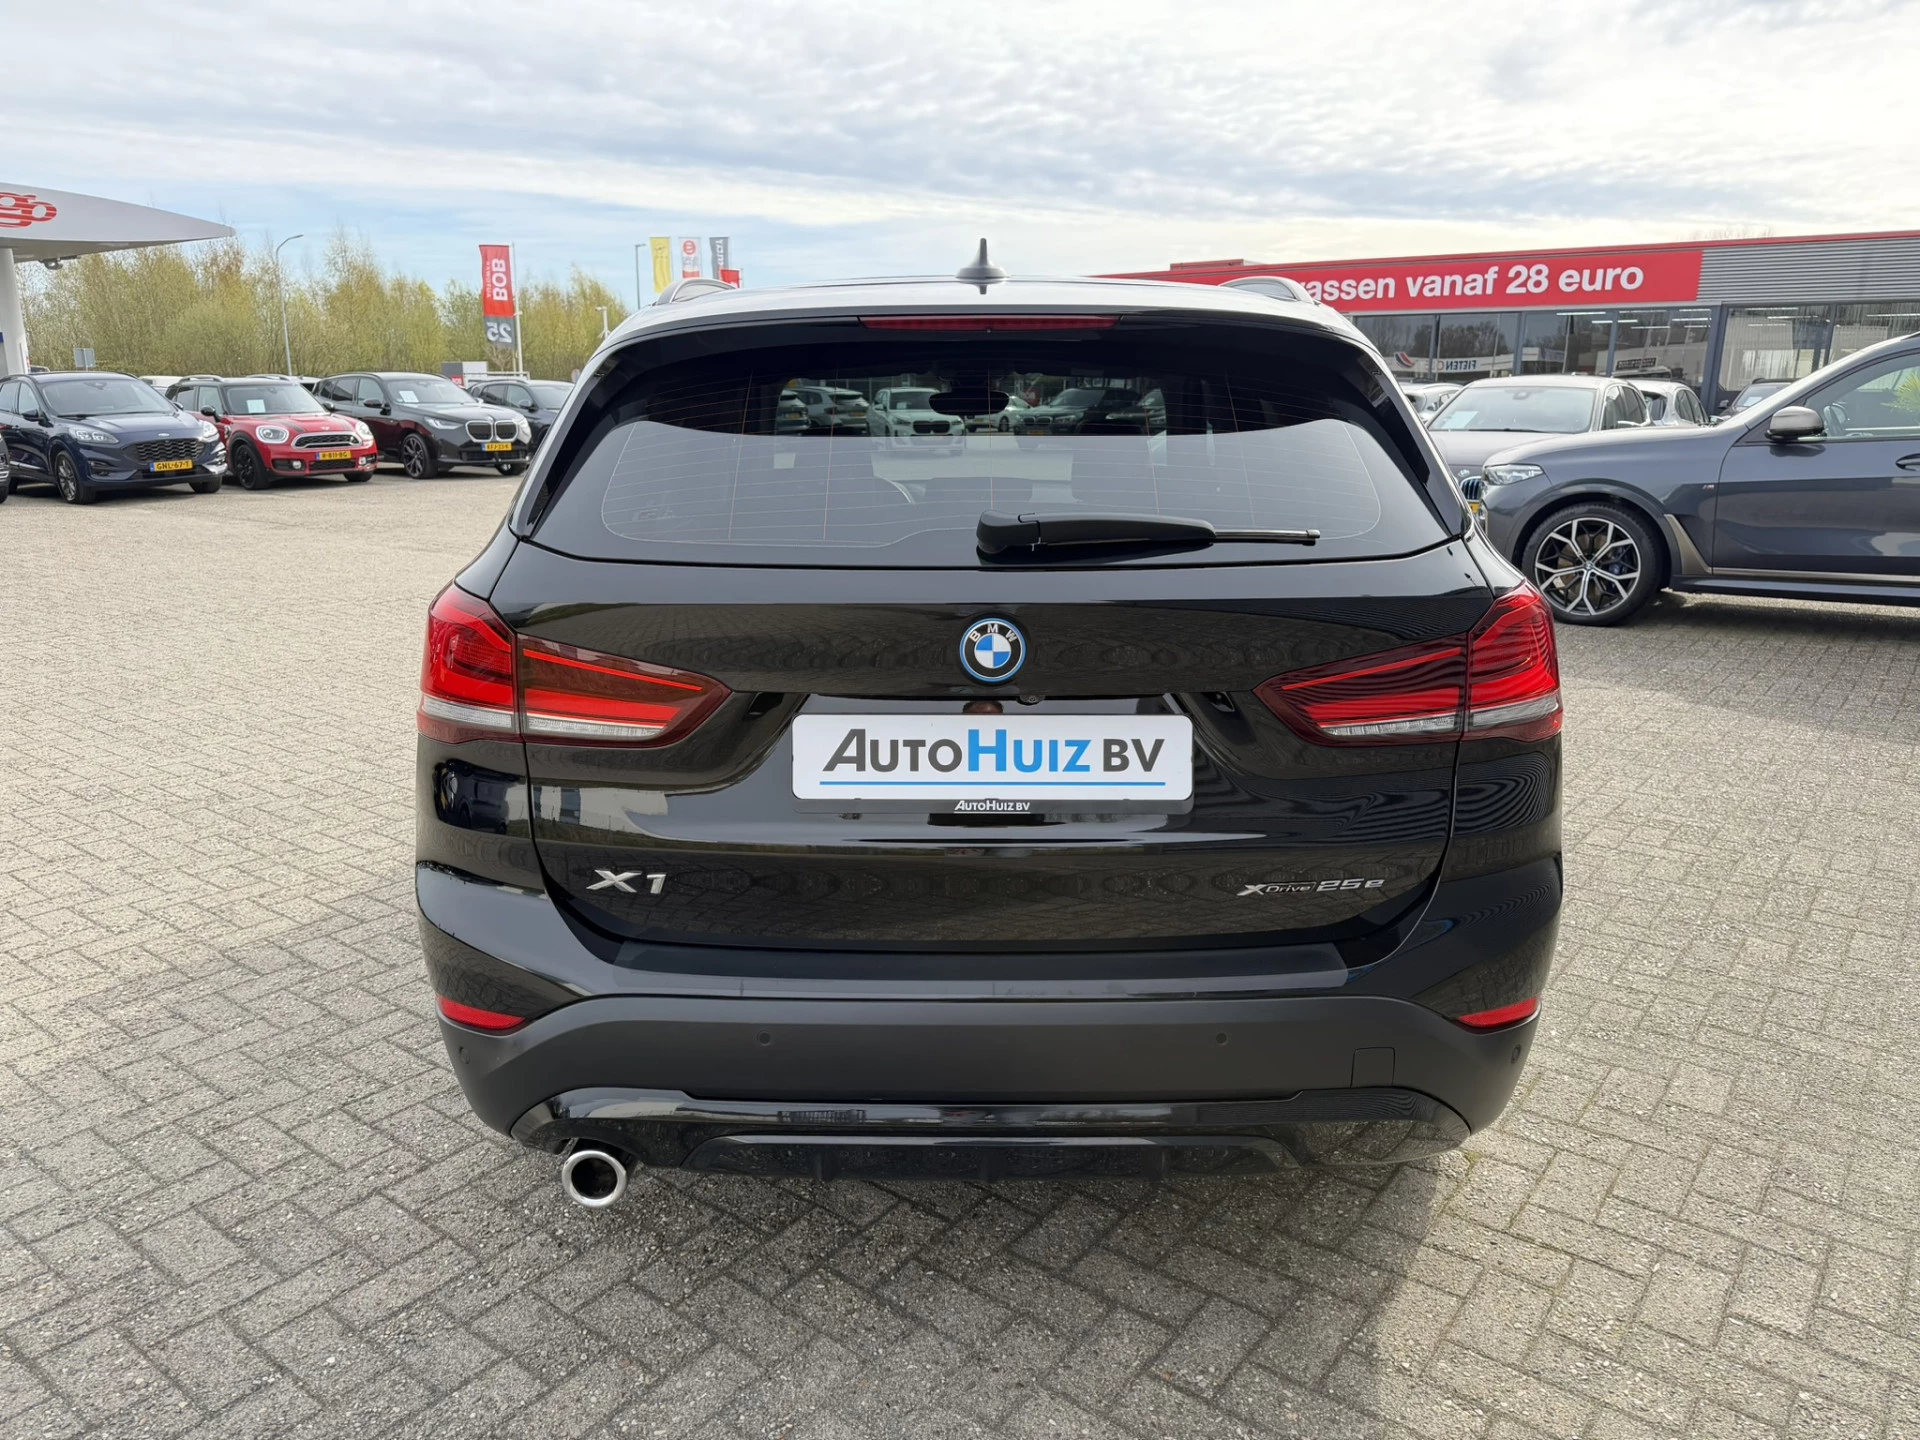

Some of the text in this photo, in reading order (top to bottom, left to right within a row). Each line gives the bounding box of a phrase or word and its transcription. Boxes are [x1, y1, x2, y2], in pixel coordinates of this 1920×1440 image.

[1405, 266, 1499, 298] vanaf
[1505, 263, 1550, 295] 28
[1558, 266, 1644, 293] euro
[968, 623, 1017, 642] BMW
[1103, 738, 1165, 772] BV
[1015, 802, 1030, 811] BV
[585, 869, 667, 894] X1
